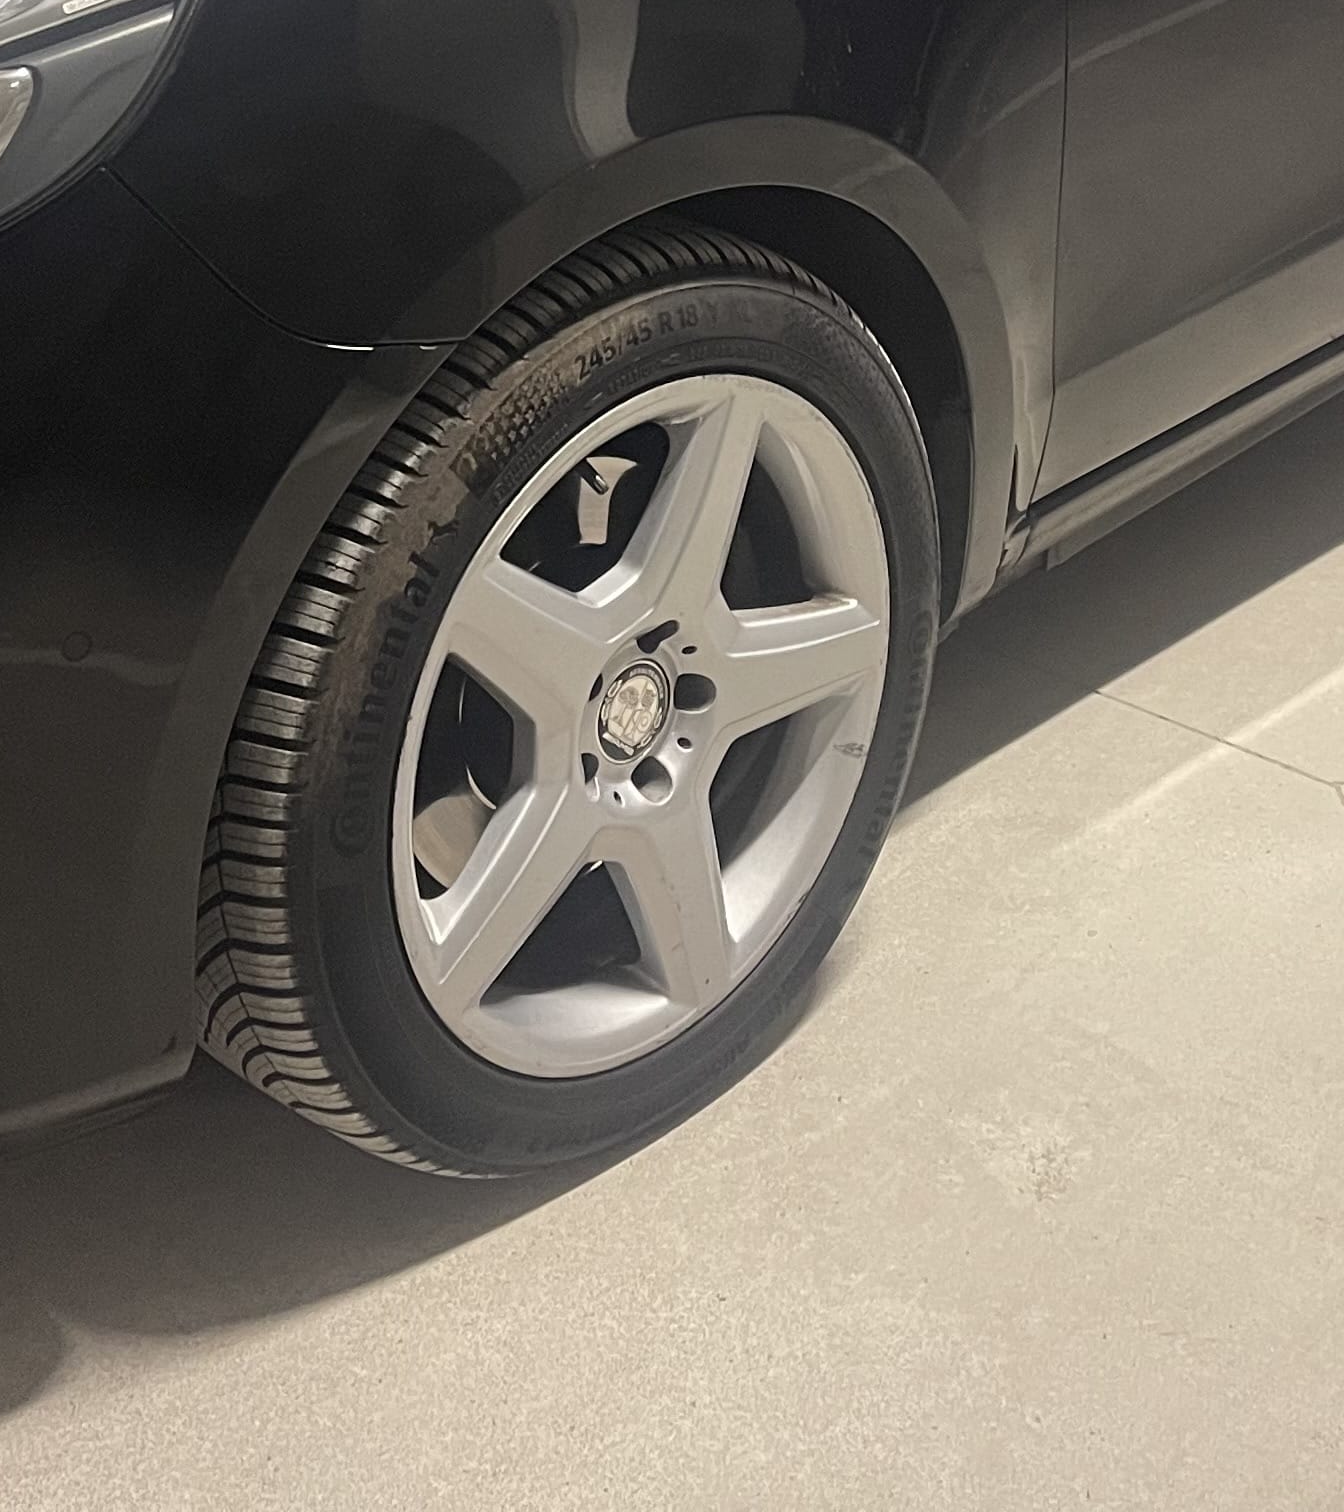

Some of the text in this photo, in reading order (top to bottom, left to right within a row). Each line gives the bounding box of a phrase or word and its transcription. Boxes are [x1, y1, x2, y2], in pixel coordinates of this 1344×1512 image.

[575, 318, 653, 380] 245/45
[659, 312, 674, 335] R
[330, 551, 441, 858] Continental
